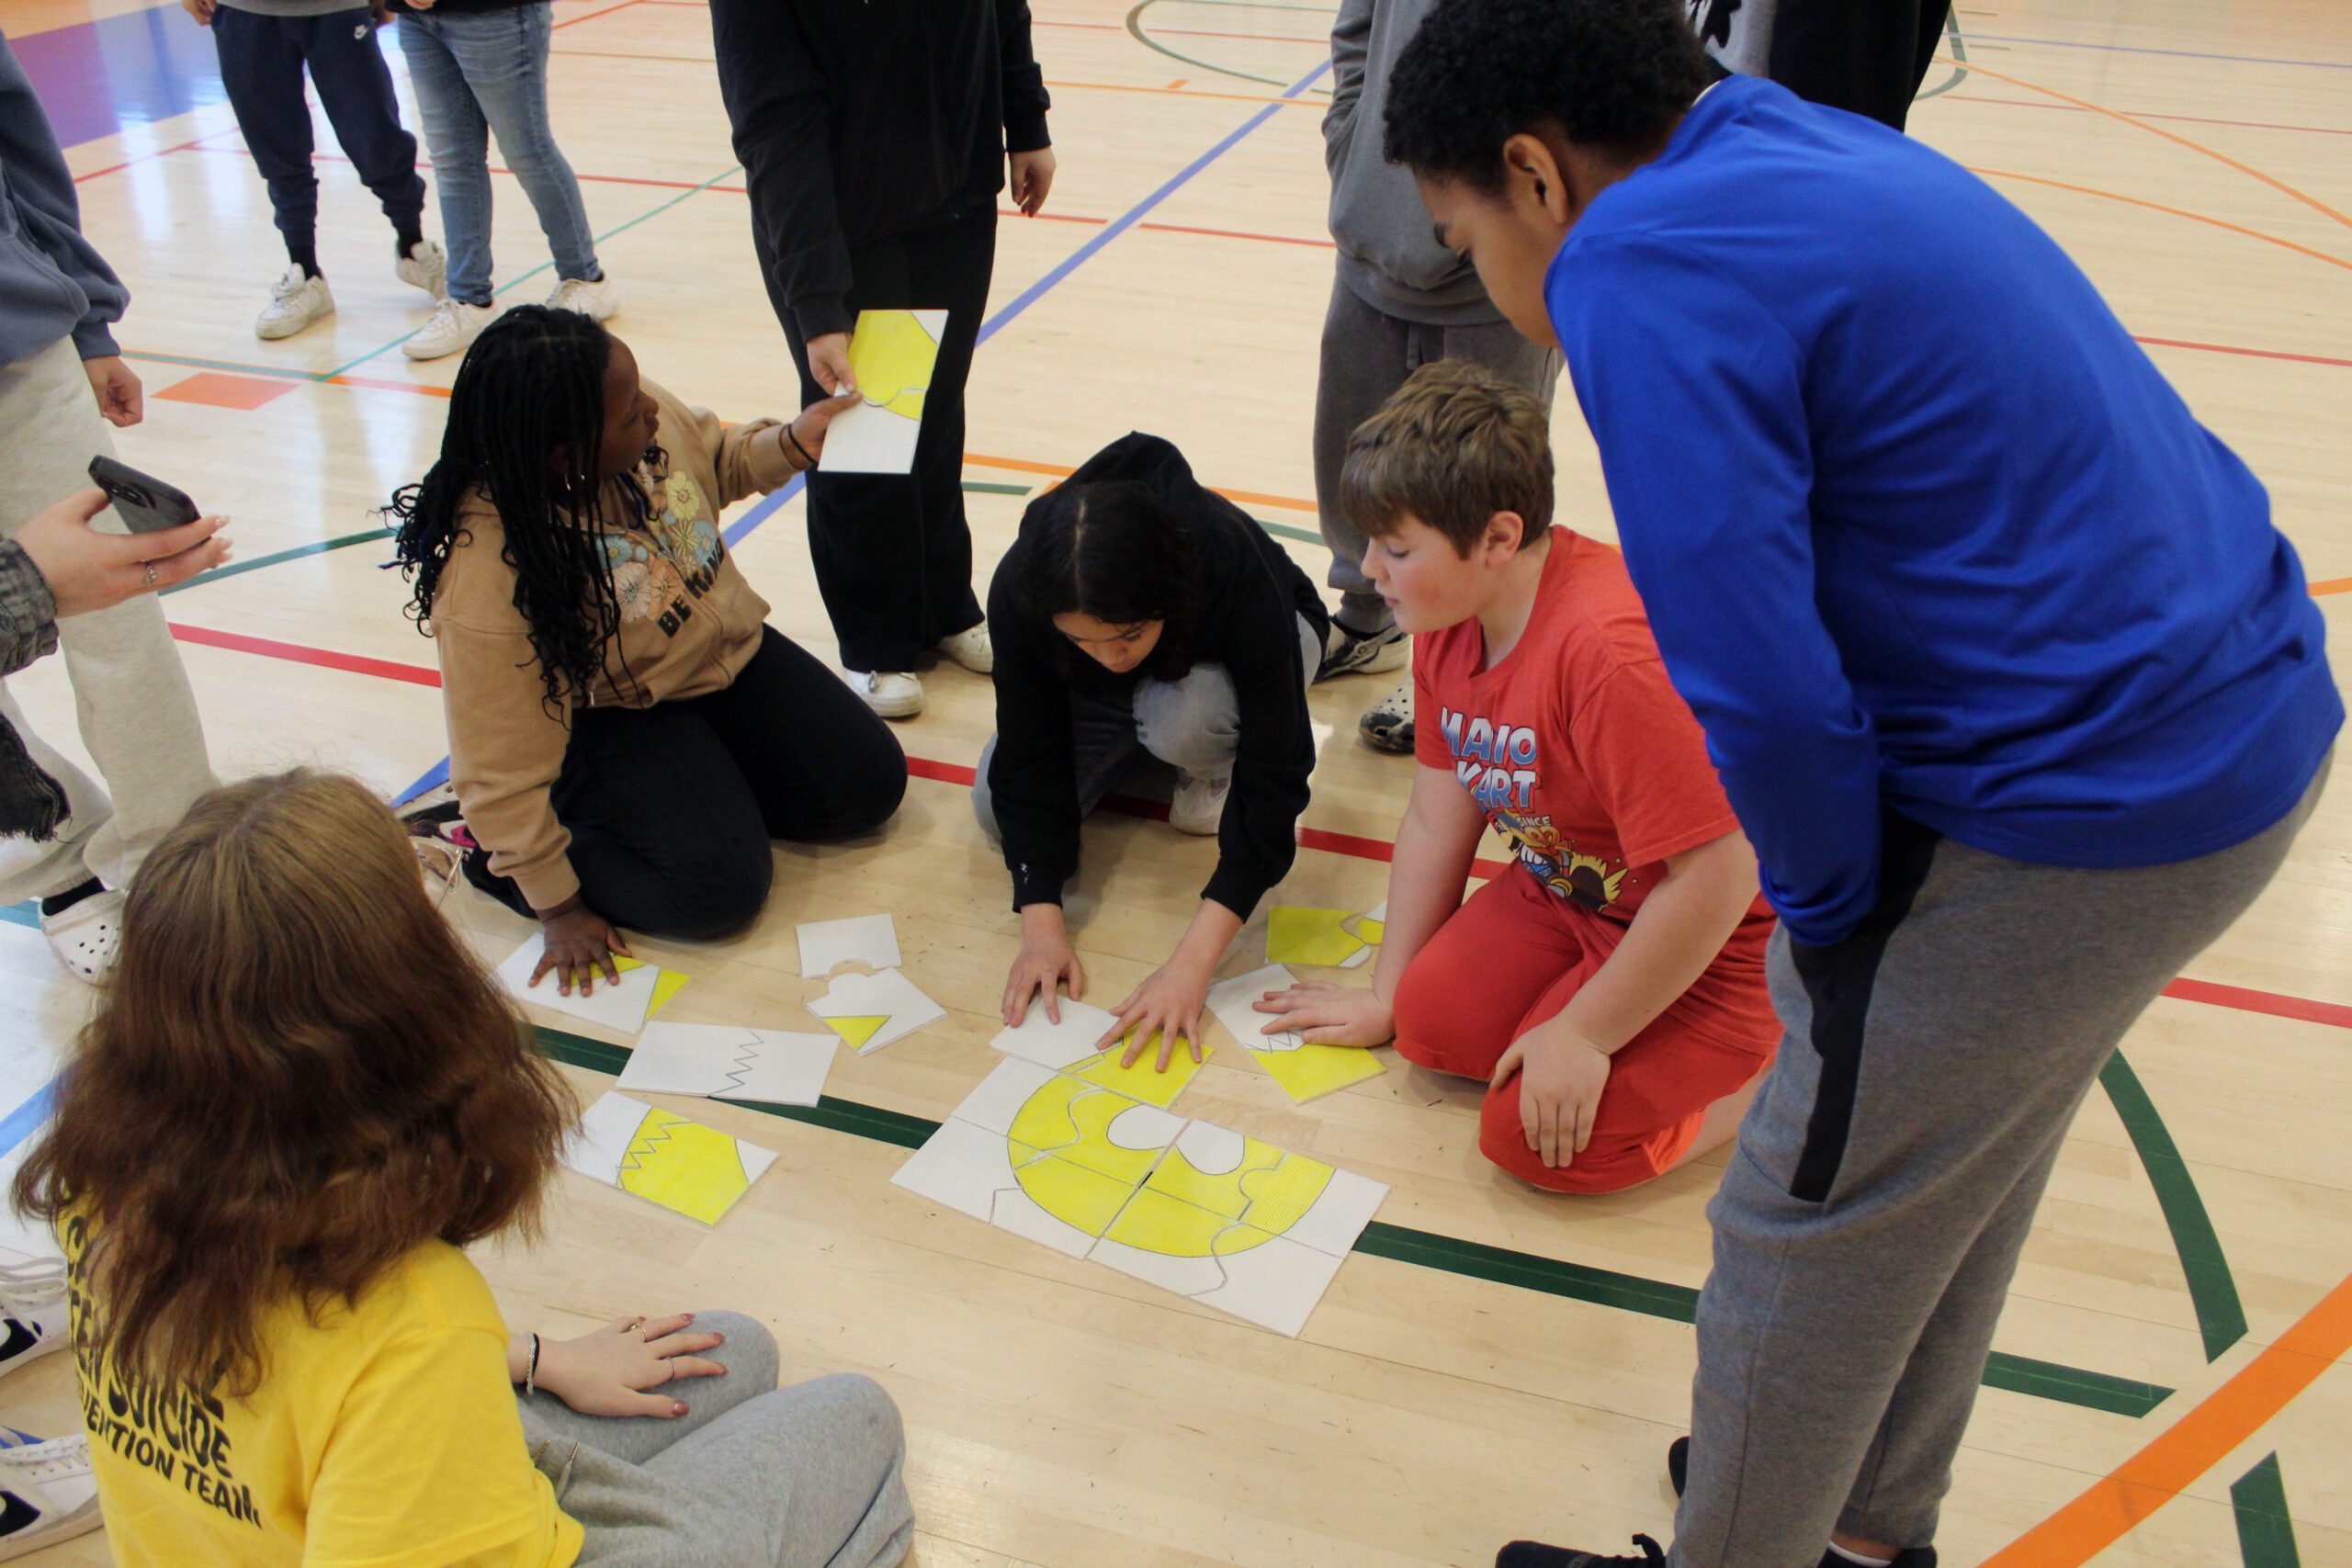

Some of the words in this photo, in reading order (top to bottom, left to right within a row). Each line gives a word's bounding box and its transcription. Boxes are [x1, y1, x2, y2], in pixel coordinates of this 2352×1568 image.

[657, 595, 691, 638] BE
[684, 536, 725, 600] KIND
[1441, 705, 1537, 765] MAIO
[1457, 761, 1538, 808] KART
[1515, 816, 1551, 828] SINCE
